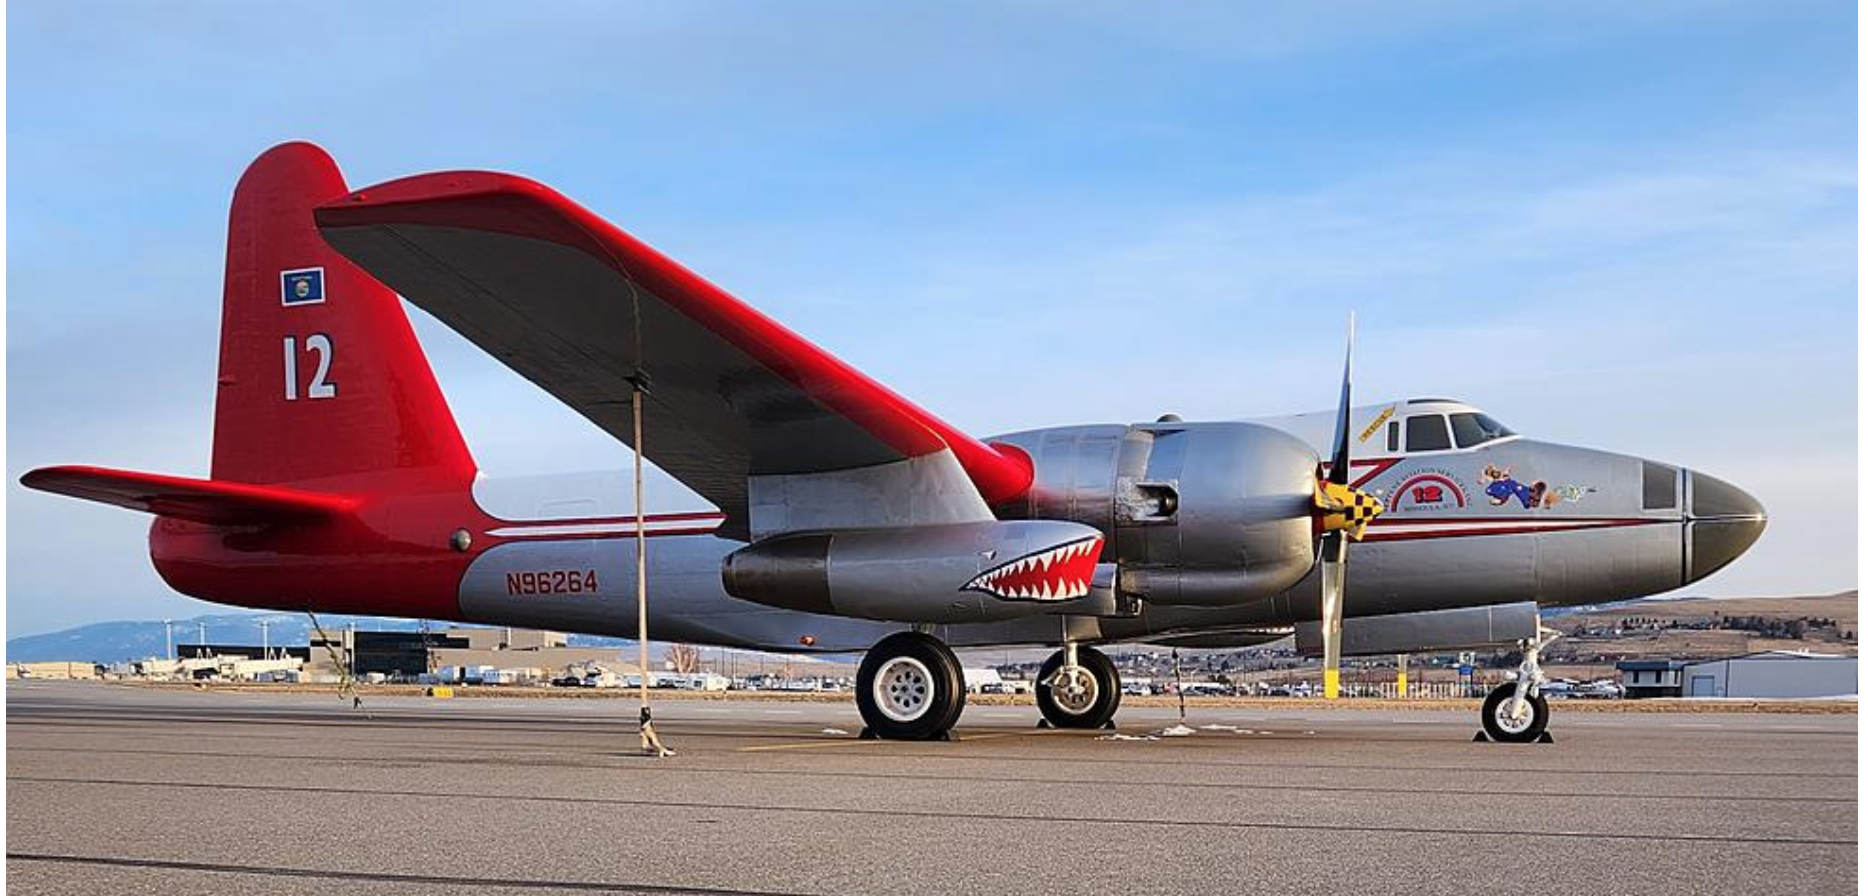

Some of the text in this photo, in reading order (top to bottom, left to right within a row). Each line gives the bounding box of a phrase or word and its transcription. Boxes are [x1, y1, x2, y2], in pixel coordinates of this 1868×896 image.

[283, 334, 337, 400] 12
[1411, 485, 1443, 504] 12
[506, 569, 598, 596] N96264
